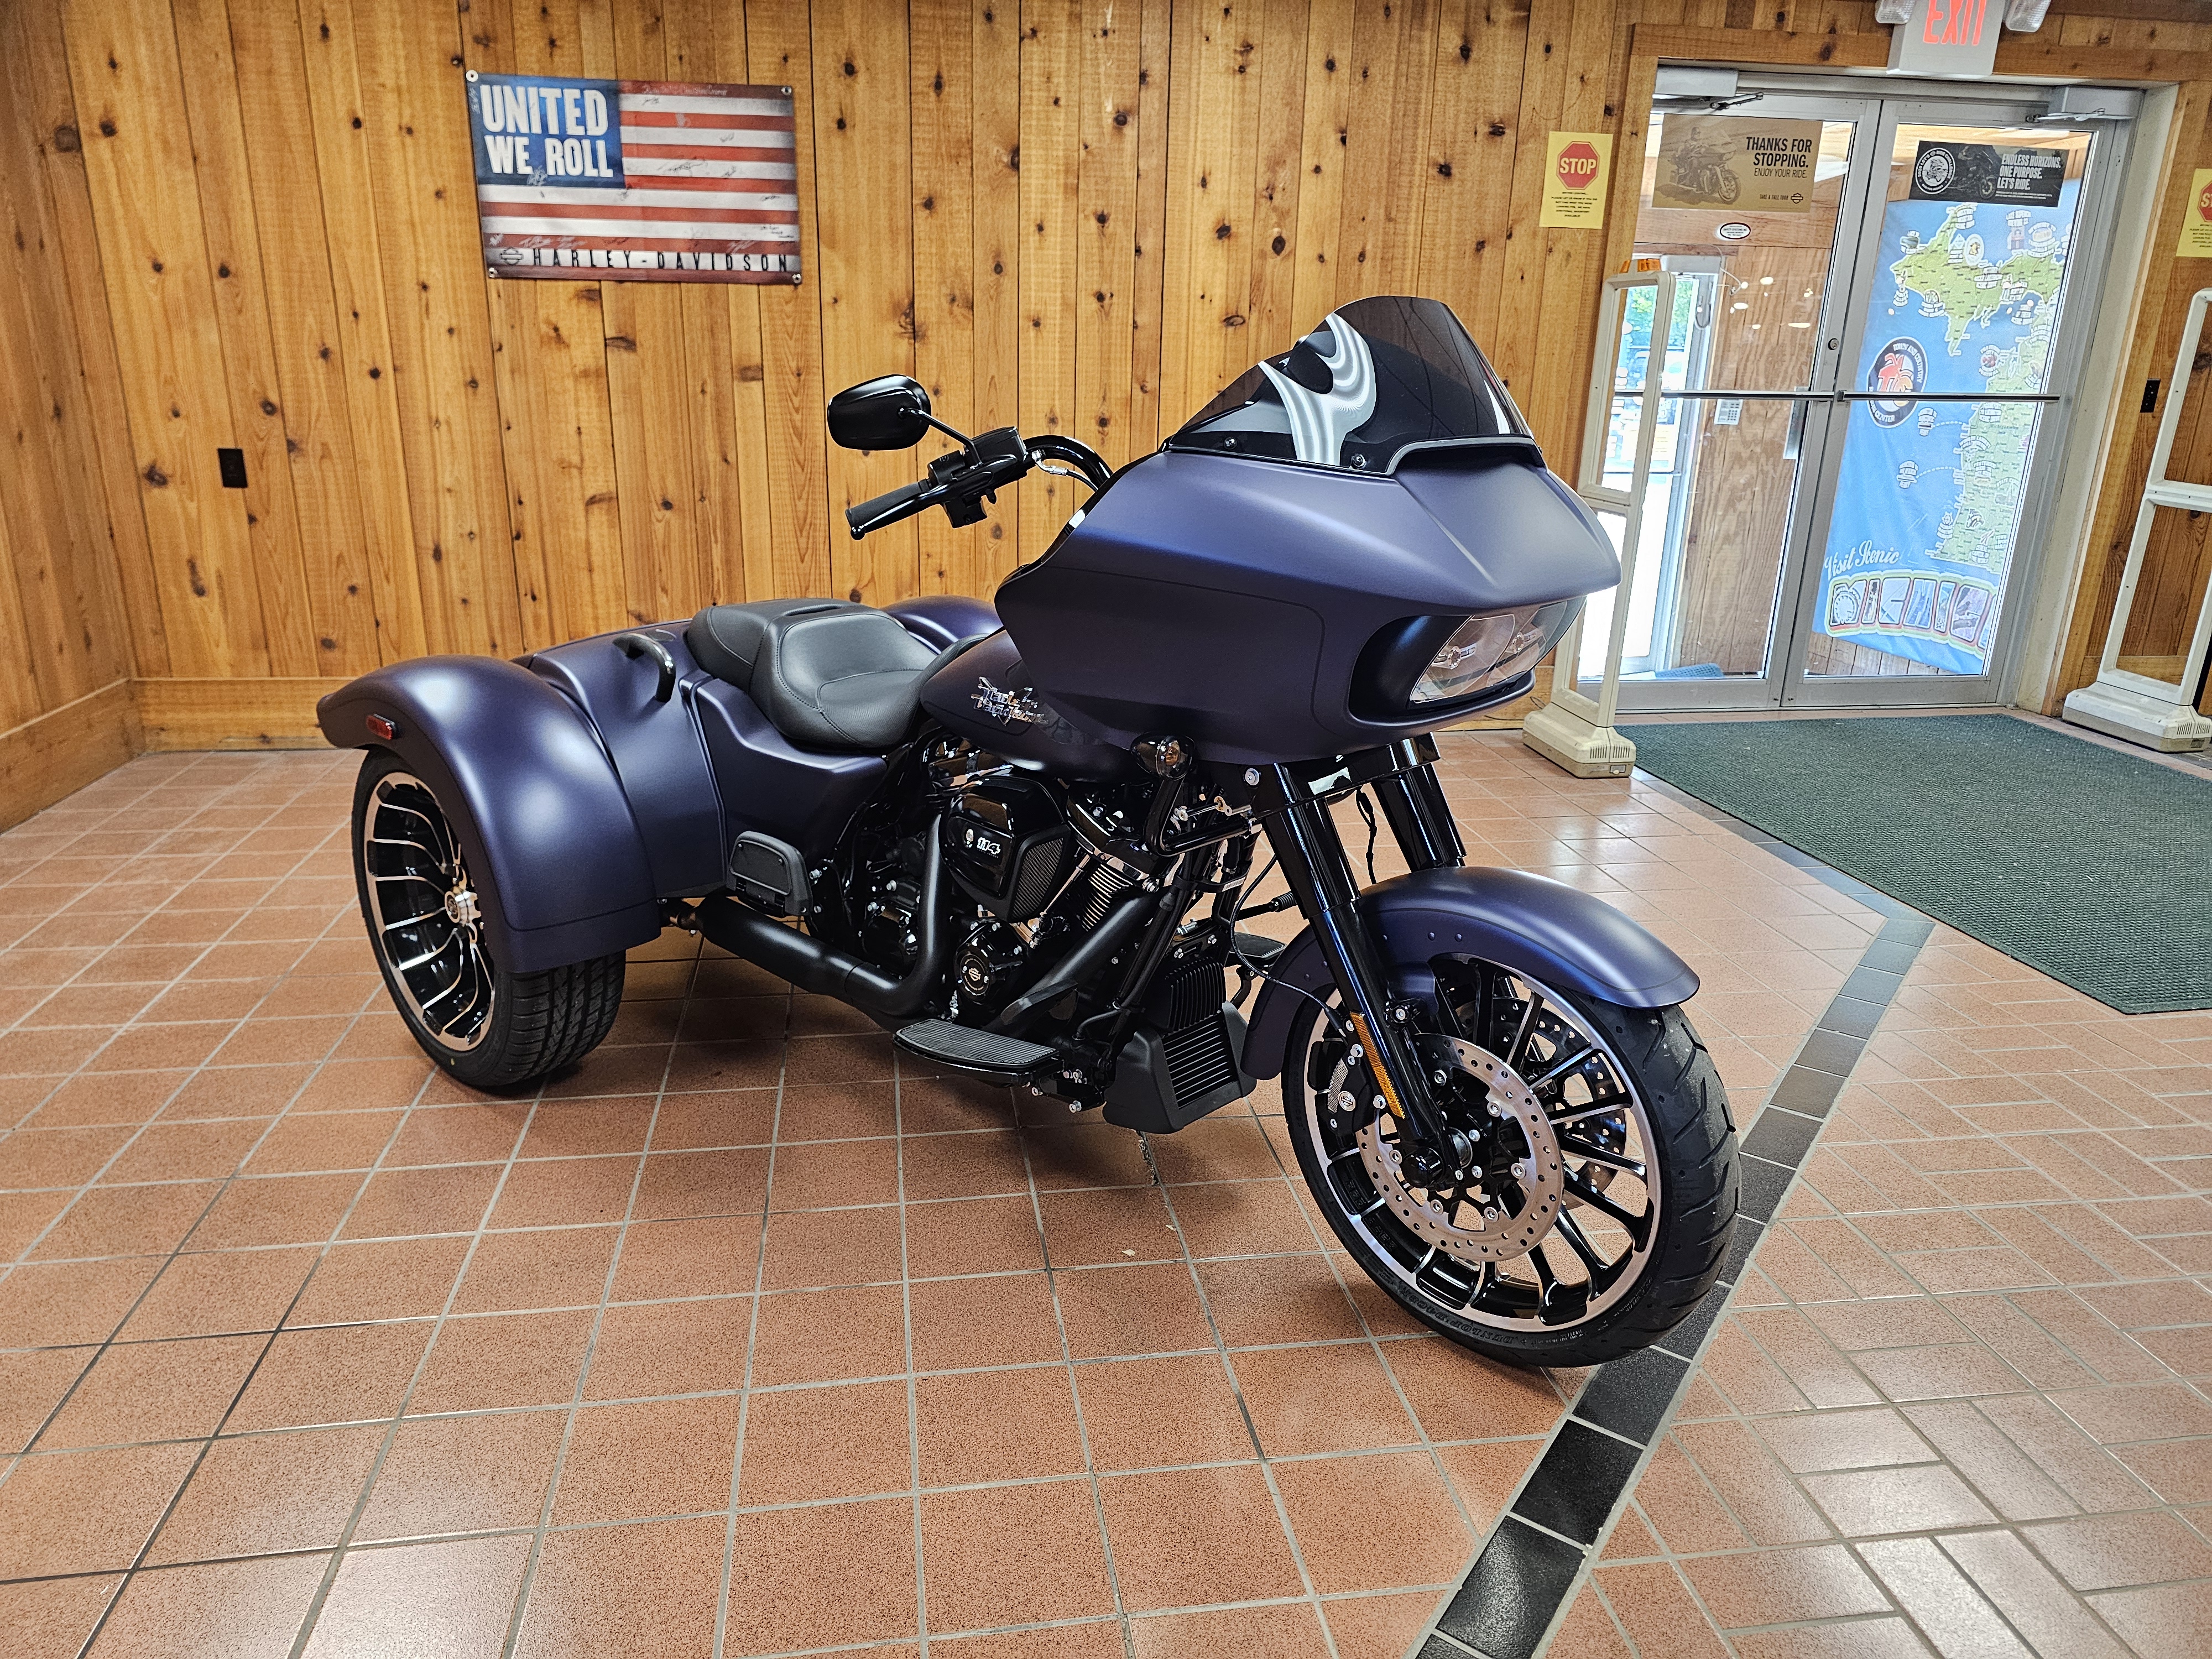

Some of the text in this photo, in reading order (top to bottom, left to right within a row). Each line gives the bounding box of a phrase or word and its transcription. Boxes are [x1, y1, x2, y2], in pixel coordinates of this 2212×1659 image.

[480, 85, 608, 136] UNITED
[1746, 137, 1812, 153] THANKS FOR
[484, 135, 533, 174] WE
[544, 138, 613, 177] ROLL
[1753, 153, 1808, 168] STOPPING.
[2001, 154, 2061, 168] ENDLESS HORIZONS.
[1559, 158, 1597, 174] STOP
[1754, 168, 1773, 176] ENJOY
[1775, 169, 1791, 178] YOUR
[2000, 165, 2042, 179] ONE PURPOSE.
[1997, 177, 2031, 190] LET'S RIDE.
[533, 248, 787, 273] HARLEY-DAVIDSON
[1824, 540, 1900, 581] Visit Scenic
[977, 837, 1001, 855] 114
[1451, 1319, 1514, 1344] DUNLOP
